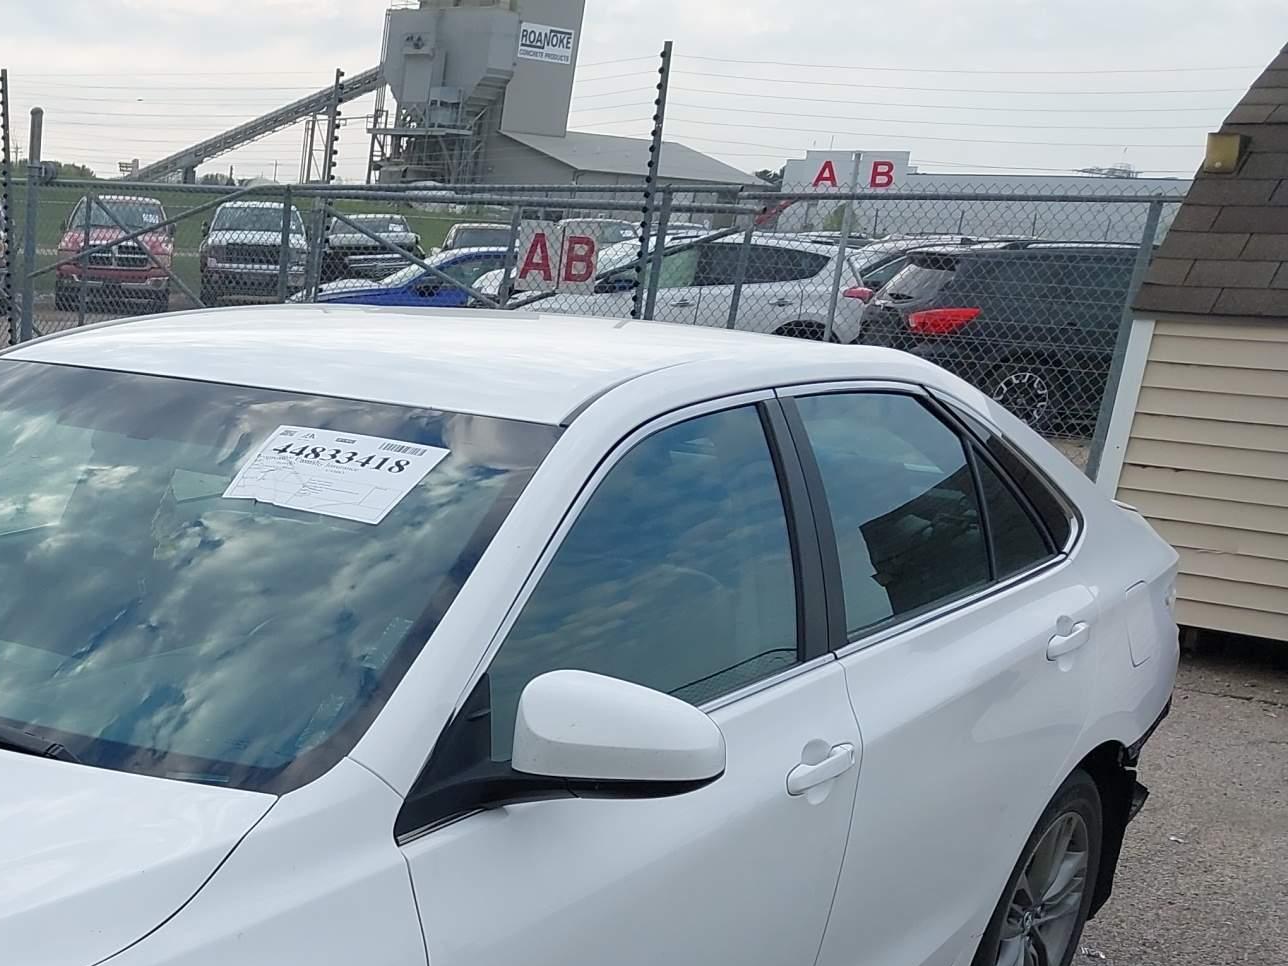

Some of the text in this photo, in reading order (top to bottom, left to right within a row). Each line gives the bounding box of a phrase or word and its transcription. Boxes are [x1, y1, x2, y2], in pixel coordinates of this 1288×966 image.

[521, 29, 572, 50] ROANOKE
[812, 160, 838, 188] A
[869, 160, 895, 188] B
[518, 232, 553, 282] A
[561, 235, 596, 282] B
[273, 443, 410, 473] 44833418
